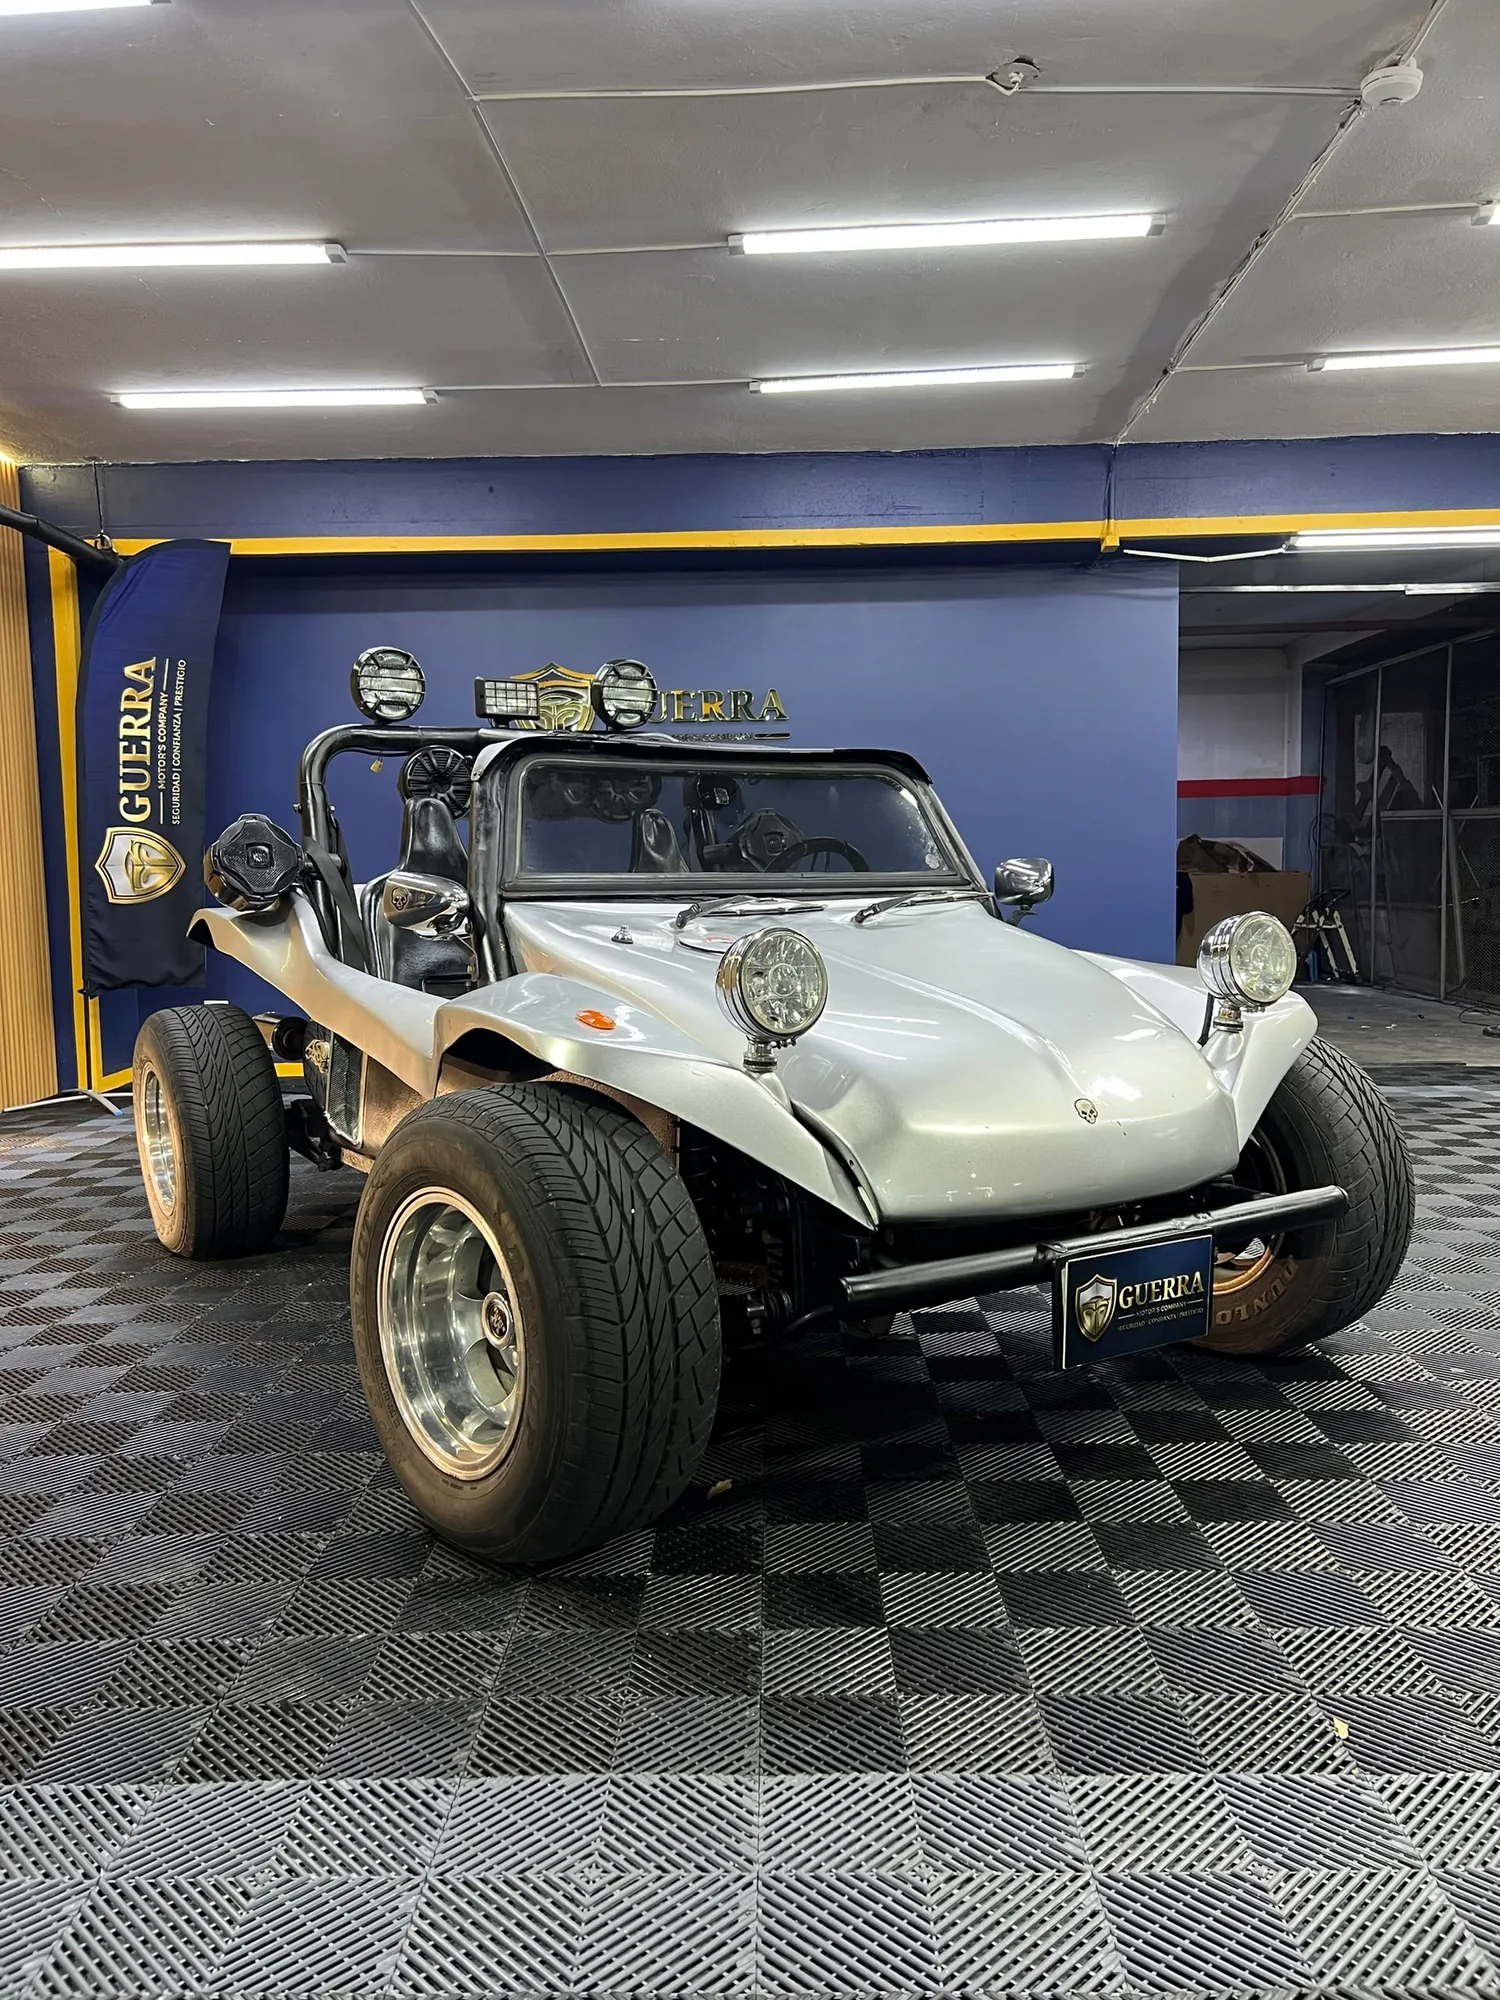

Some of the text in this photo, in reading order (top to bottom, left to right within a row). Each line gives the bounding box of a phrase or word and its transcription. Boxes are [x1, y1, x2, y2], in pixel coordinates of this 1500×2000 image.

[119, 657, 157, 823] GUERRA
[157, 692, 168, 790] MOTOR'S COMPANY
[649, 688, 791, 724] ERRA
[171, 659, 187, 825] SEGURIDAD CONFIANZA PRESTIGIO
[1118, 1271, 1205, 1309] GUERRA
[1160, 1301, 1187, 1312] COMPANY
[1215, 1254, 1300, 1325] DUNLO
